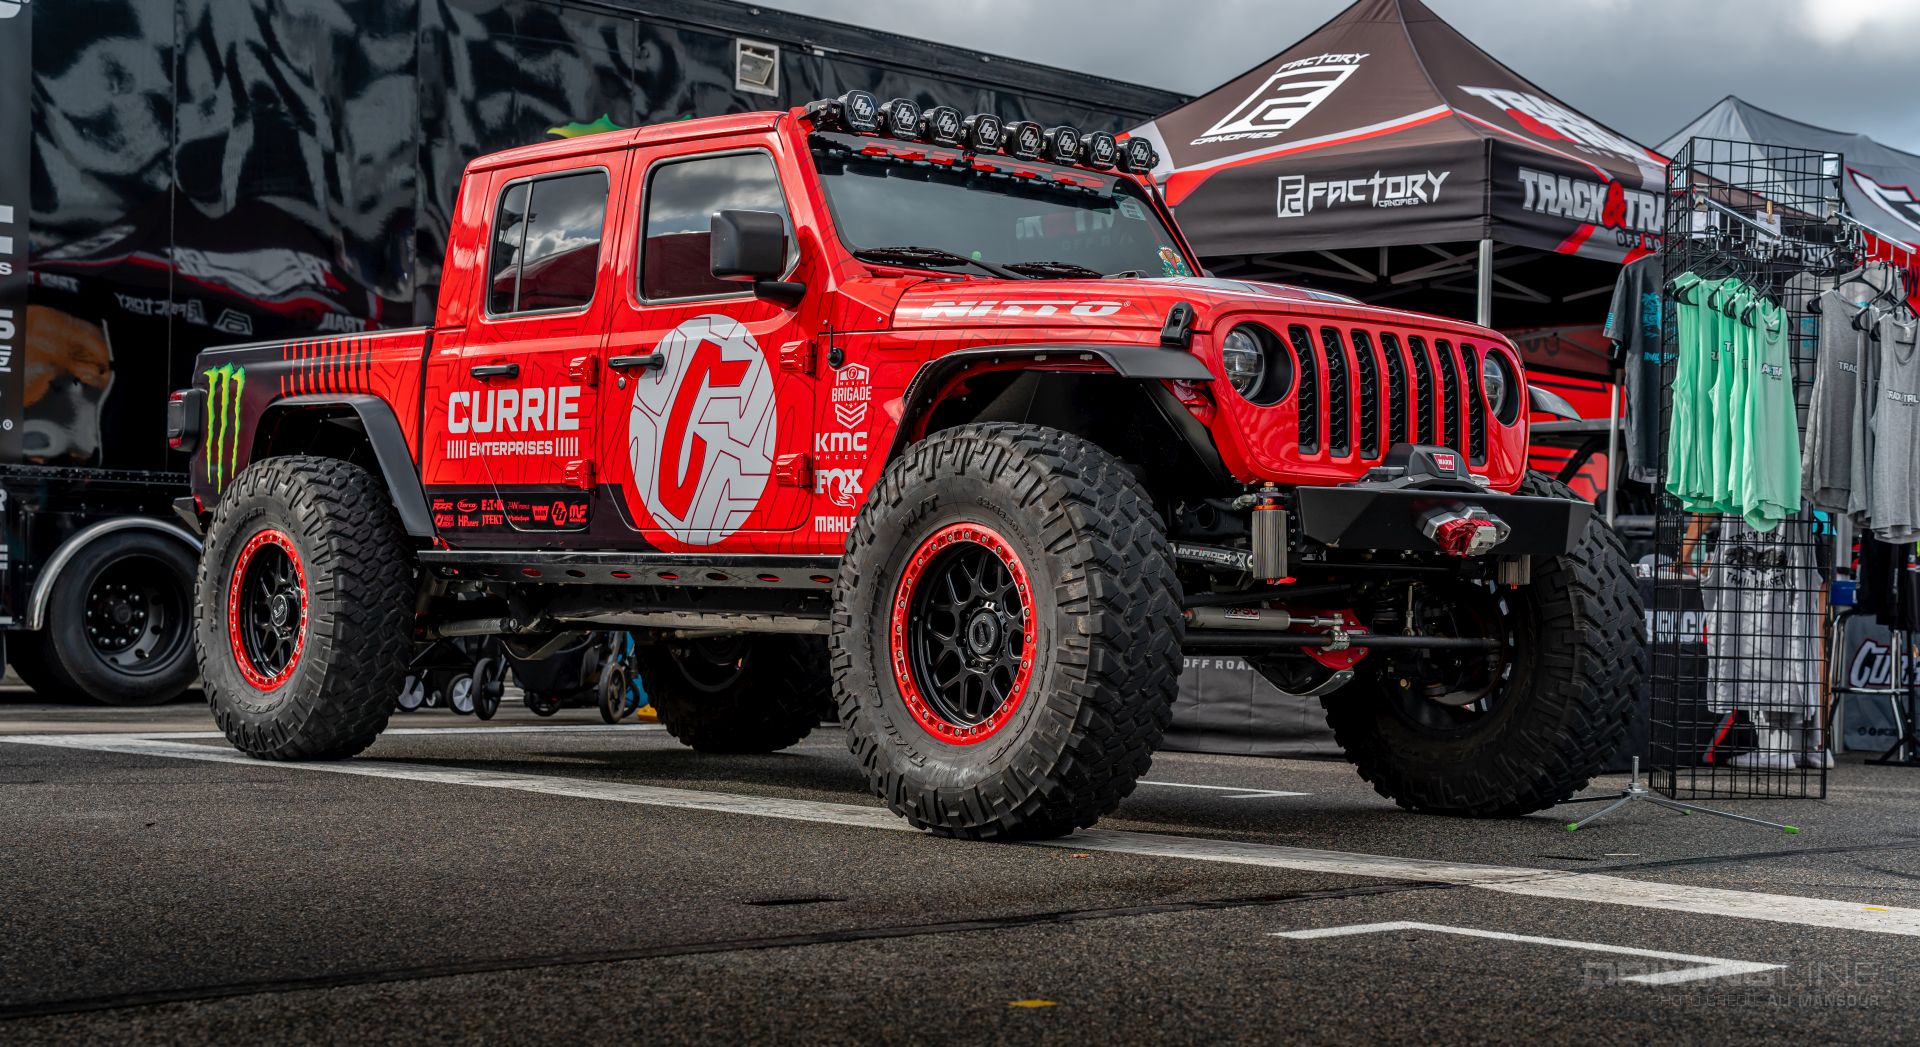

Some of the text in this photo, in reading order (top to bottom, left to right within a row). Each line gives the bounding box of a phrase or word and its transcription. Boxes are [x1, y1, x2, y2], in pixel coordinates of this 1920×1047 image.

[1275, 53, 1370, 74] FACTORY
[1308, 170, 1450, 213] FACTORY
[921, 300, 1122, 317] NITTO
[832, 386, 872, 402] BRIGADE
[448, 386, 581, 433] CURRIE
[469, 440, 553, 457] ENTERPRISES
[815, 431, 868, 452] KMC
[815, 468, 863, 496] FOX
